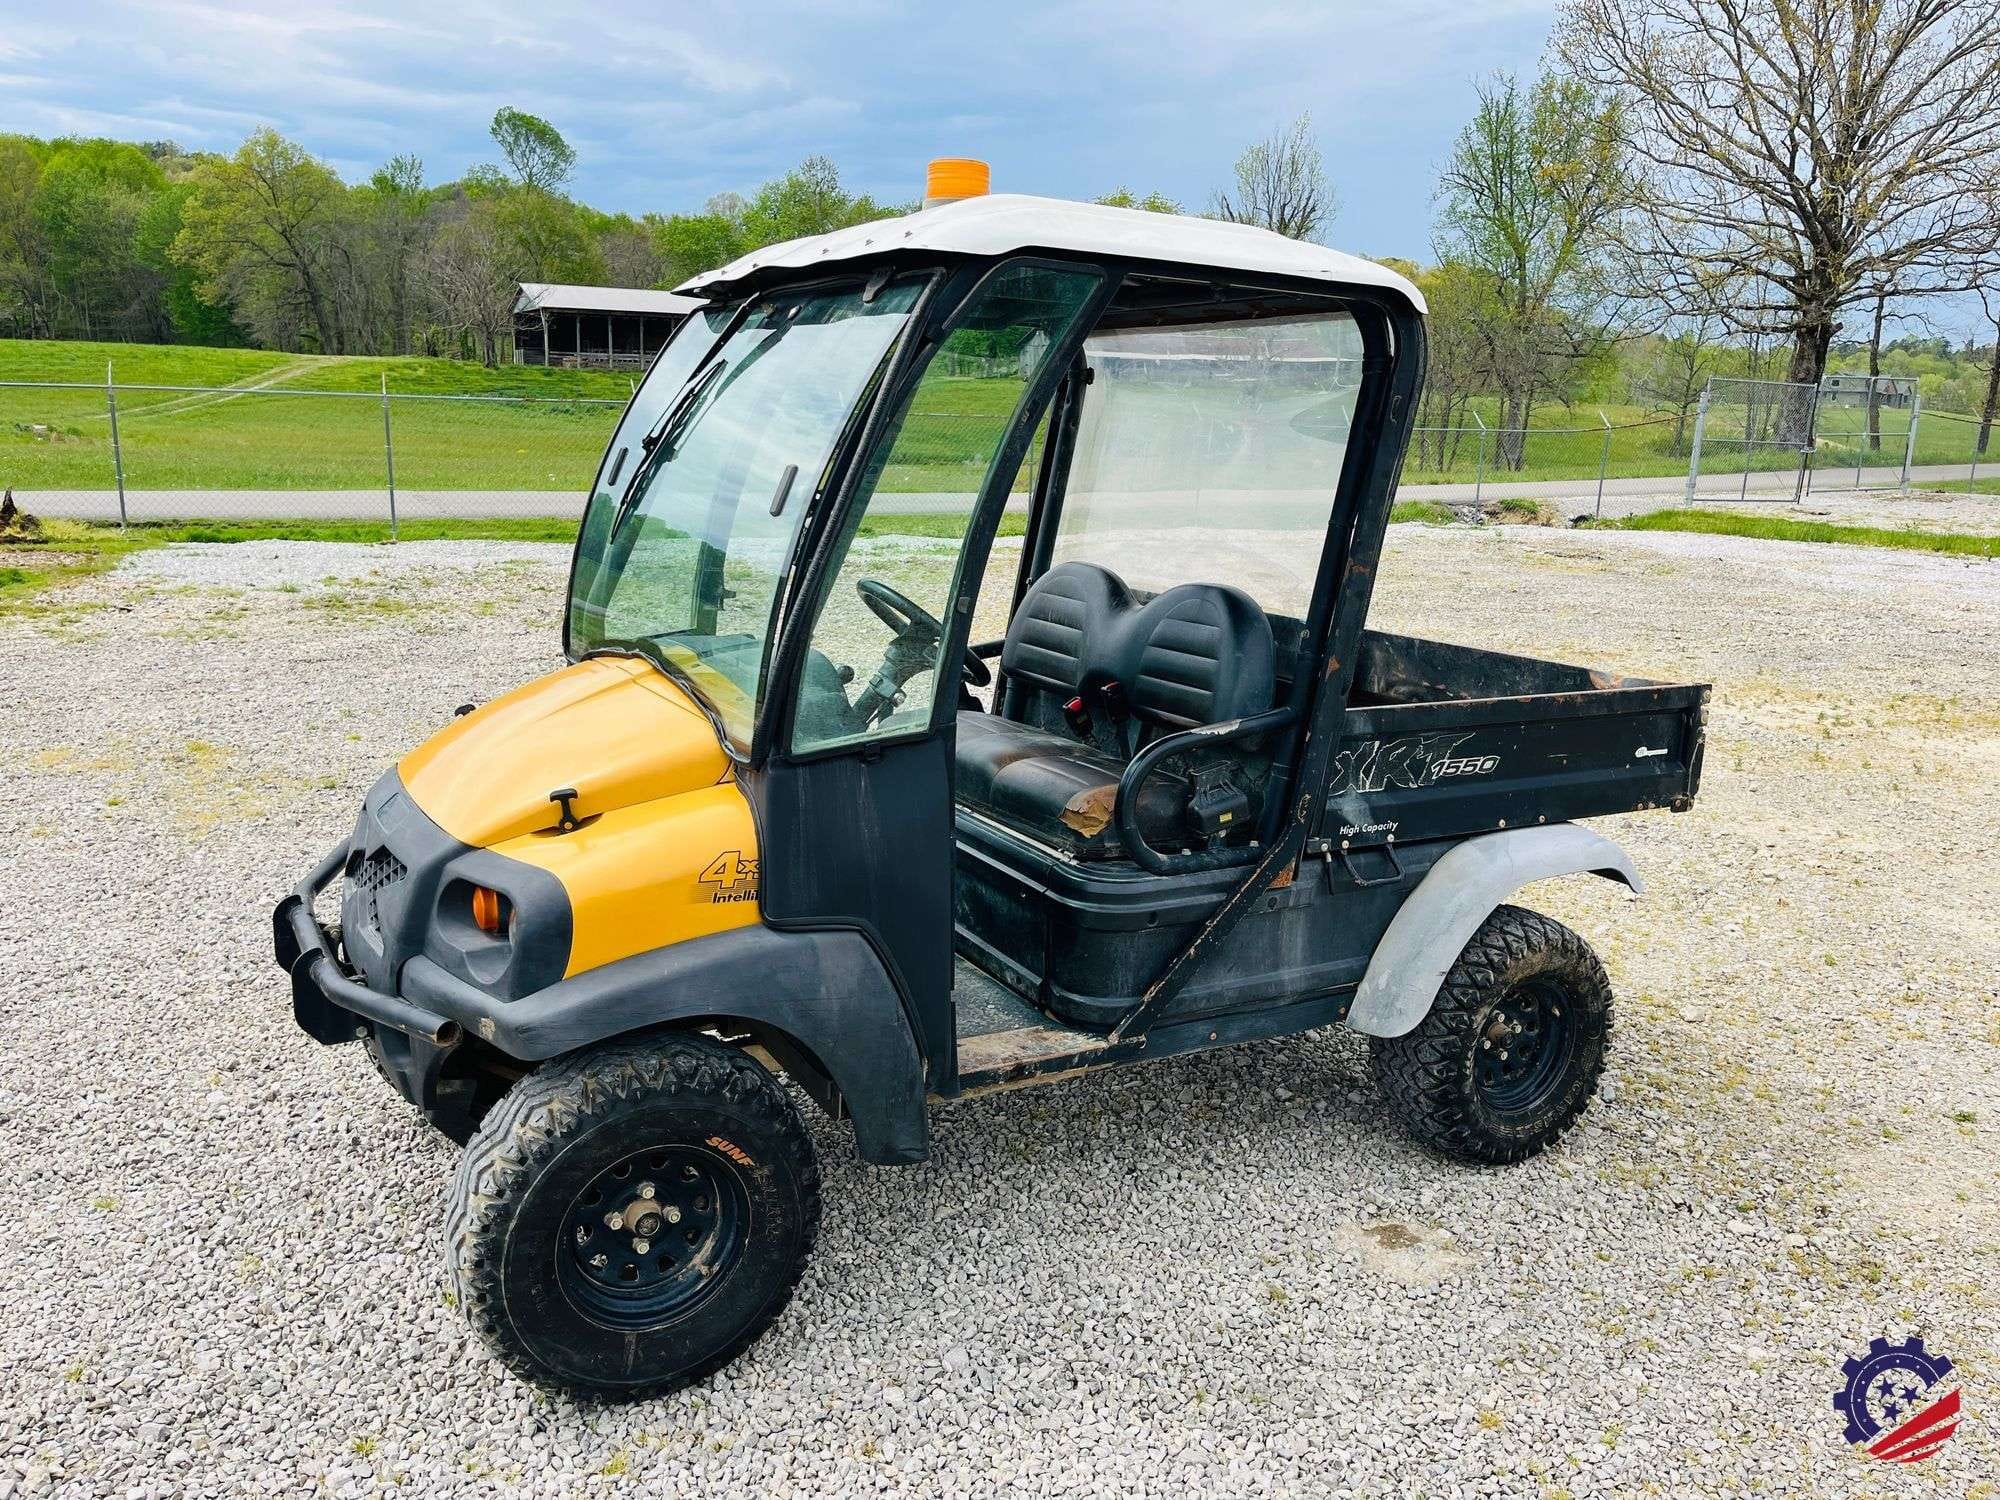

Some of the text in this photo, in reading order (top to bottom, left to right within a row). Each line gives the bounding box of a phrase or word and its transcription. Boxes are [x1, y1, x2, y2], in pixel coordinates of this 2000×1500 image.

[1328, 730, 1501, 796] XRT 1550
[1339, 820, 1399, 836] High Capacity
[697, 850, 760, 889] 4x
